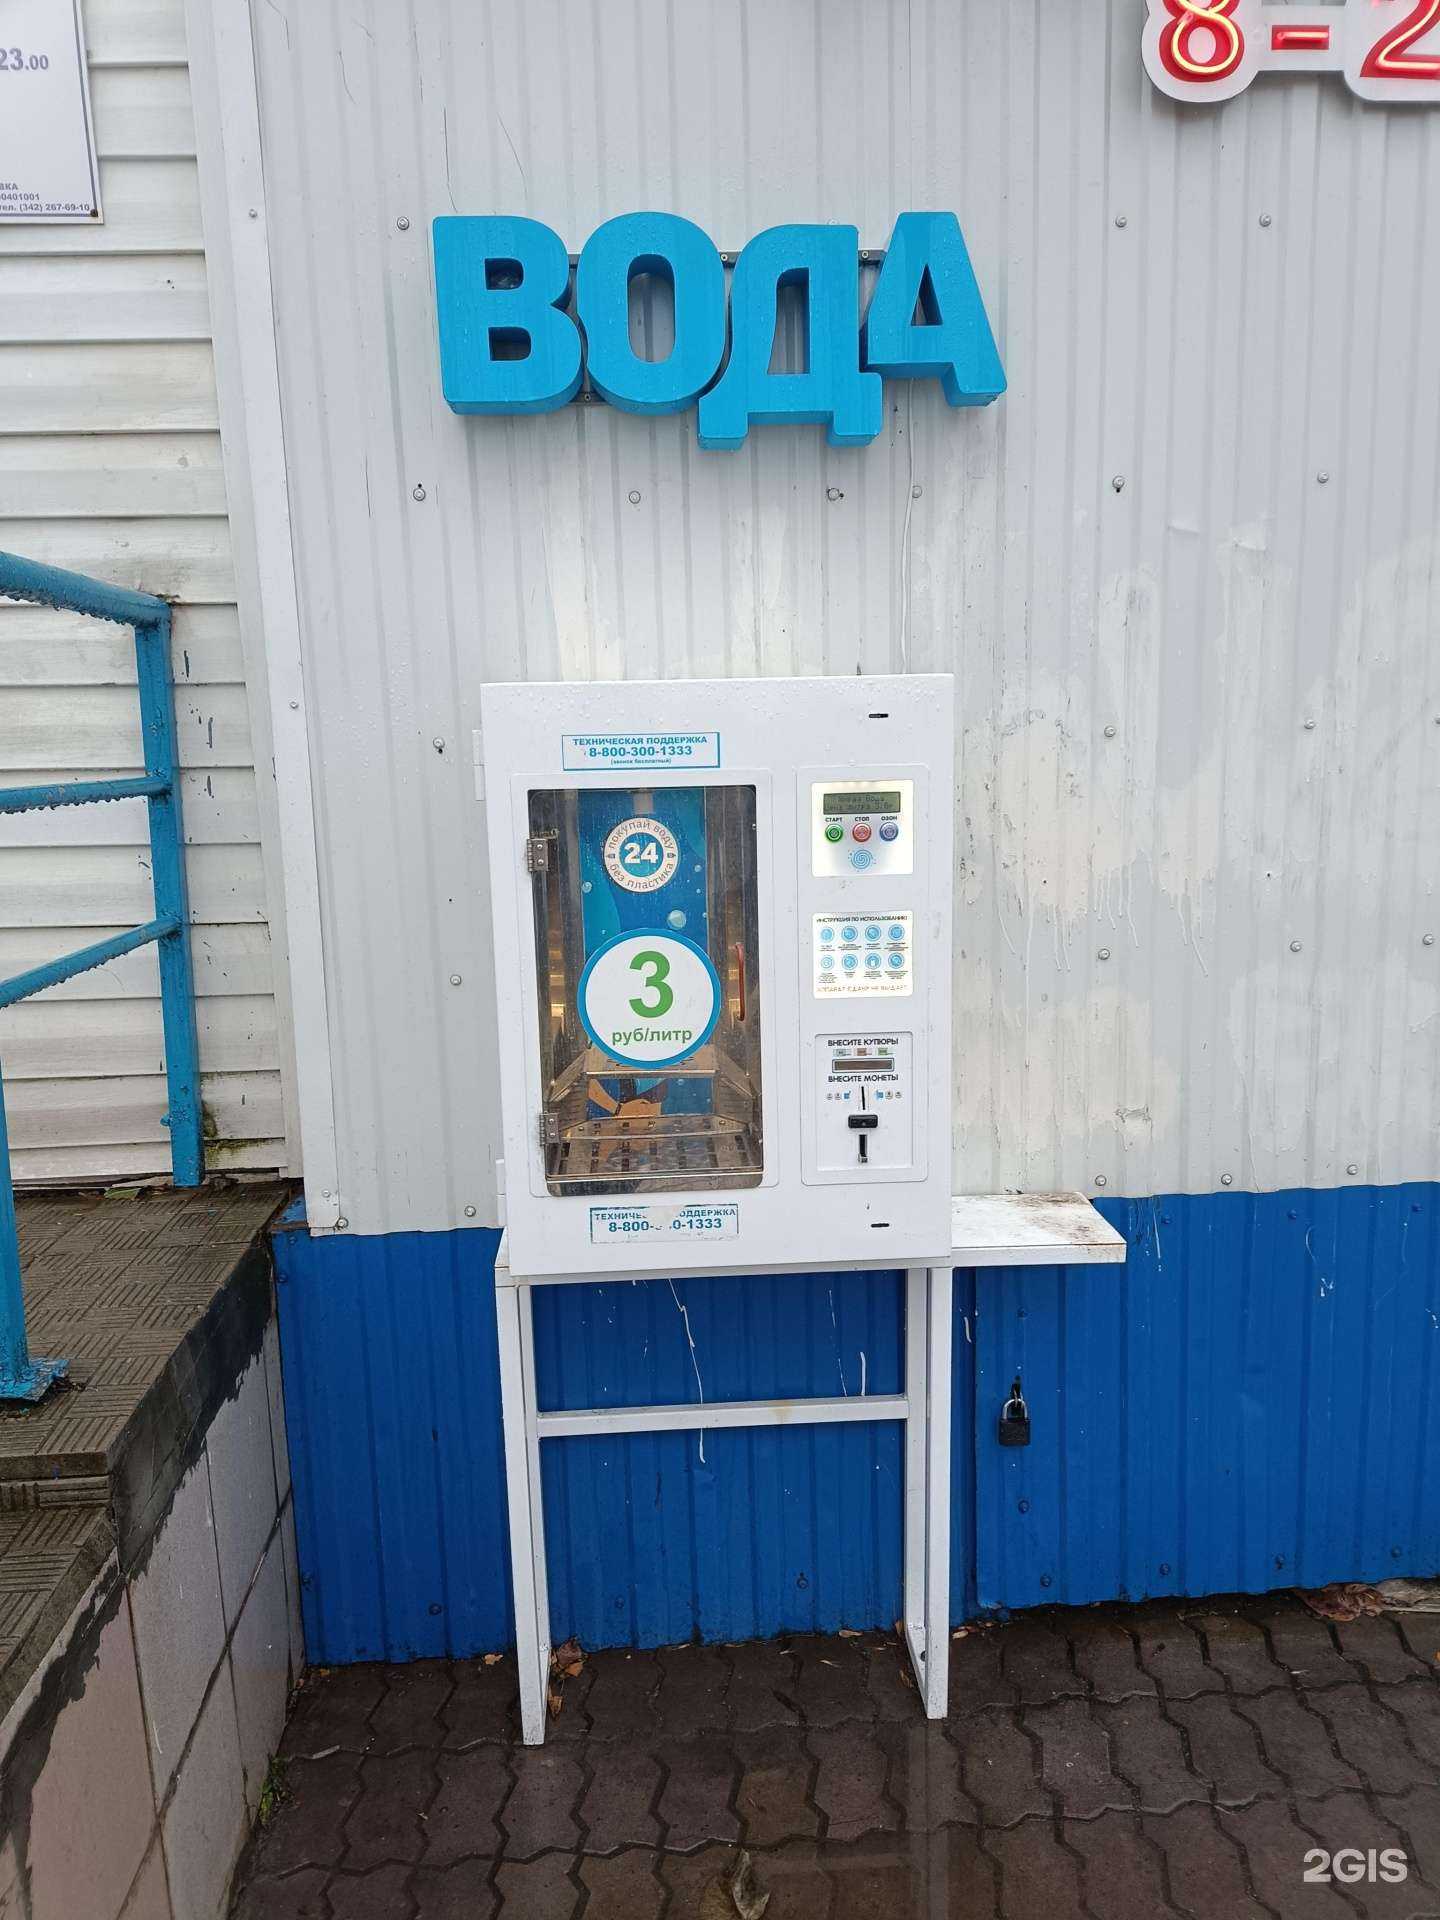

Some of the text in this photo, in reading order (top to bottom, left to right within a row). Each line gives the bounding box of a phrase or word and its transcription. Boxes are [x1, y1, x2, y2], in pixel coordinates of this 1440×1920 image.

[20, 203, 42, 212] (342)
[433, 212, 1007, 449] ВОДА
[573, 736, 707, 746] ТЕХНИЧЕСКАЯ ПОДДЕРЖКА
[589, 746, 692, 757] 8-800-300-1333
[608, 821, 675, 849] покупай воду
[624, 842, 659, 864] 24
[610, 864, 674, 889] без пластика
[628, 950, 674, 1019] 3
[612, 1027, 692, 1046] руб/литр
[864, 1074, 898, 1082] МОНЕТЫ
[676, 1209, 736, 1218] ОДДЕРЖКА
[608, 1218, 722, 1232] 8-800-0-1333
